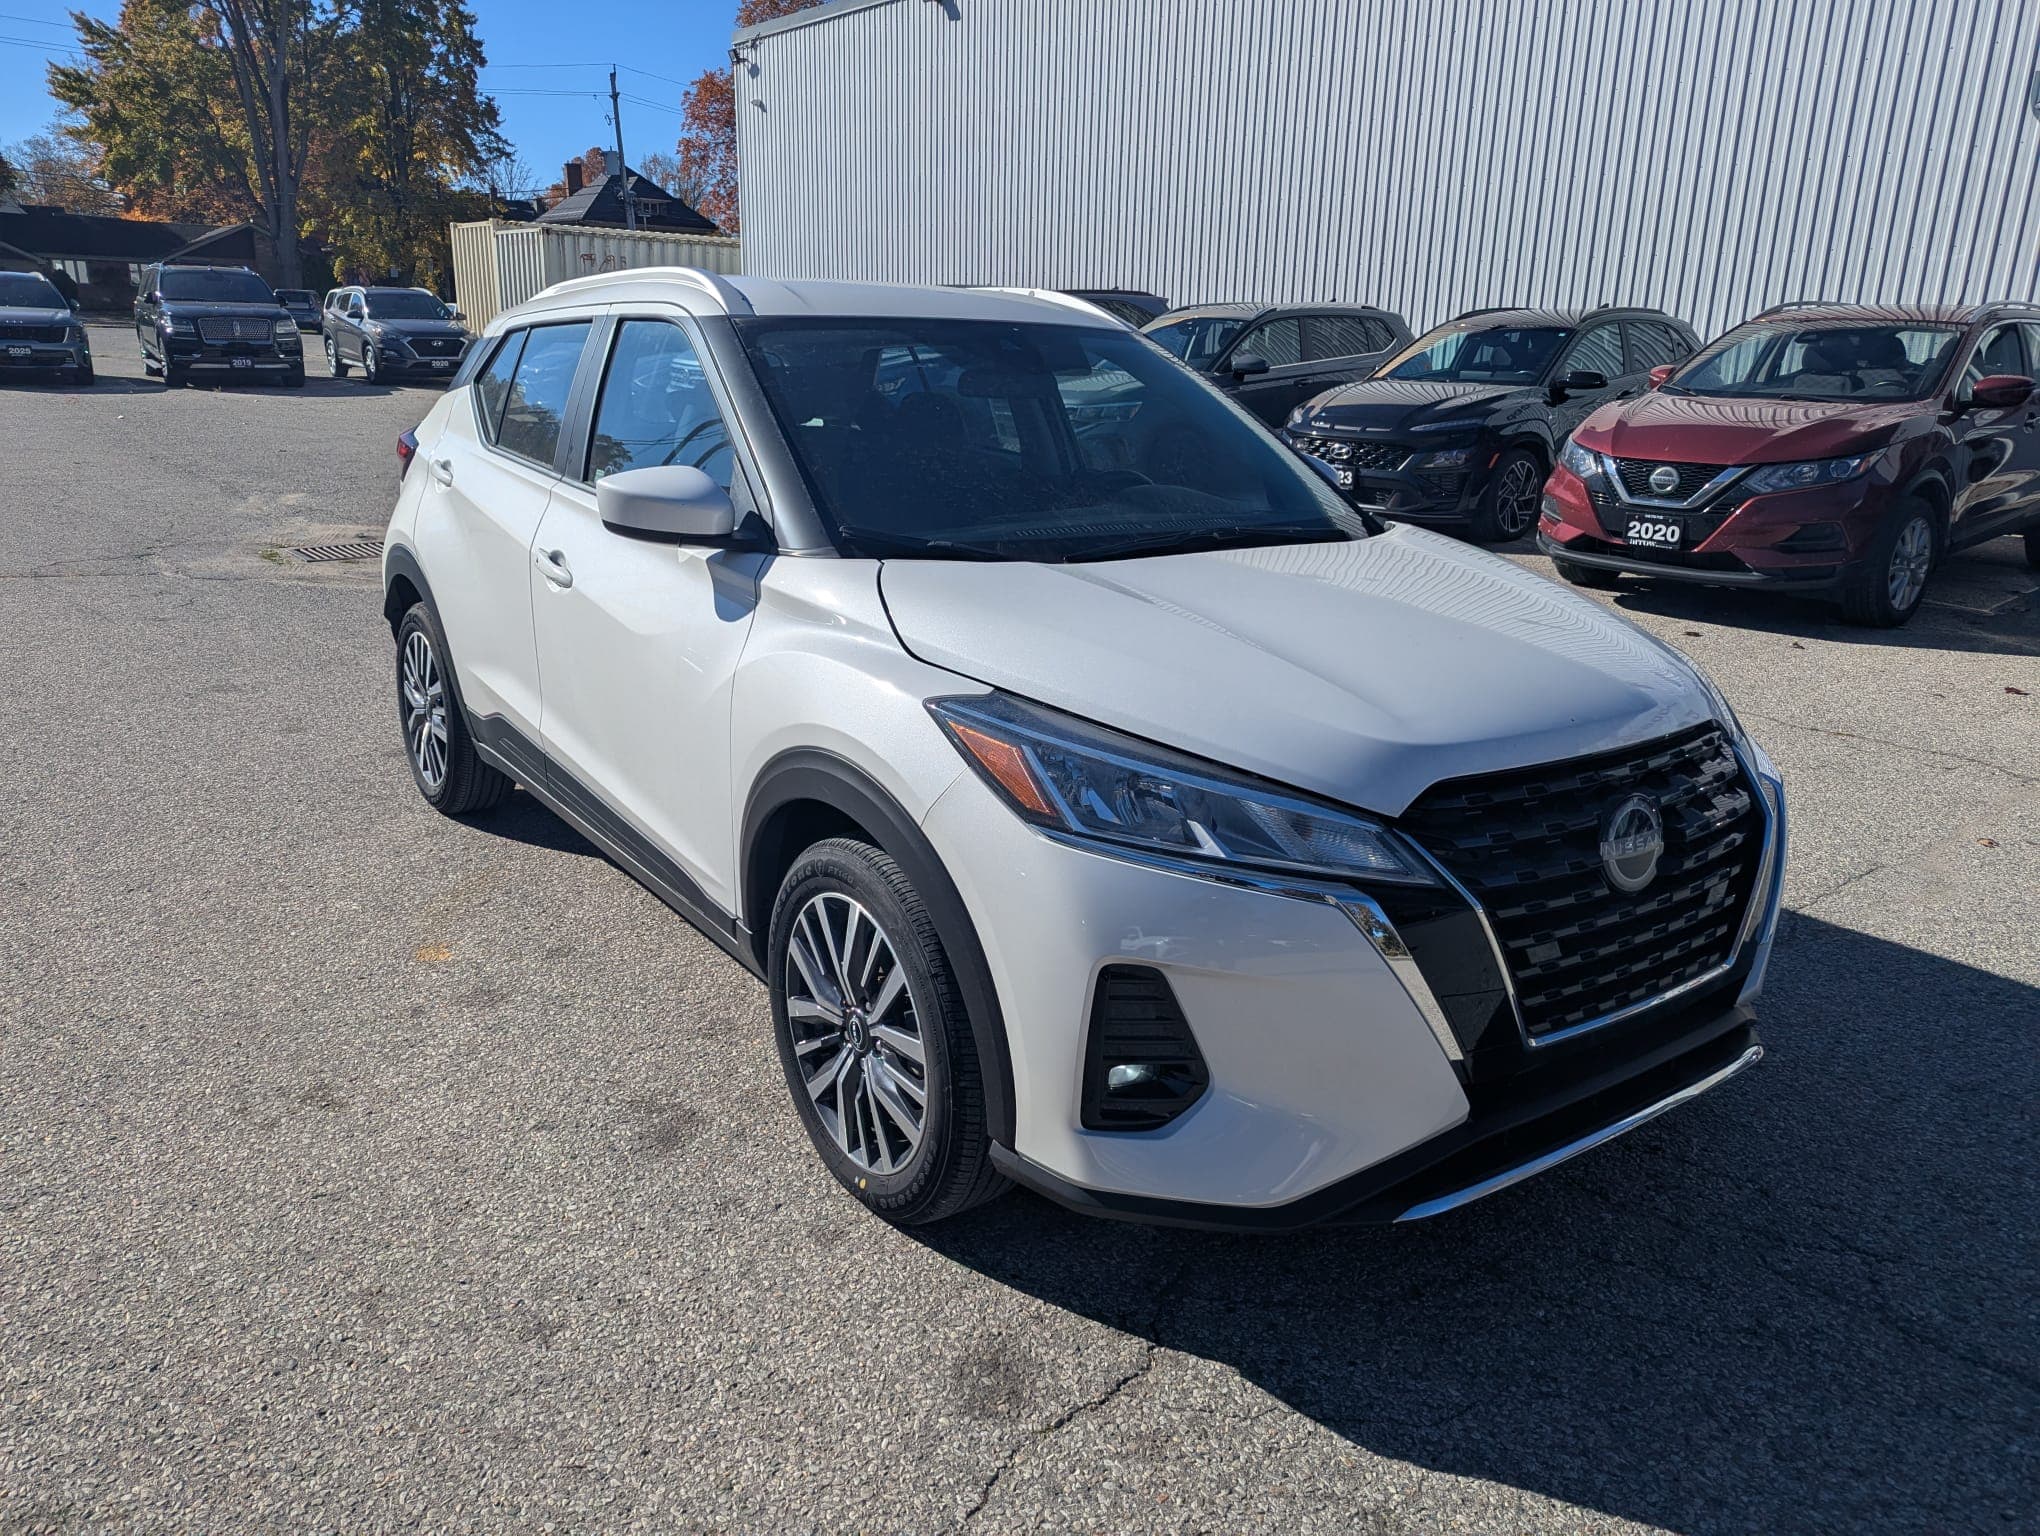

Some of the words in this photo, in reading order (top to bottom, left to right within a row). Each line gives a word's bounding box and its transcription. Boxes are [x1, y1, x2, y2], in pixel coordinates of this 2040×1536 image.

[1338, 470, 1353, 484] 23
[1627, 520, 1680, 543] 2020
[1602, 834, 1661, 857] NISSAN
